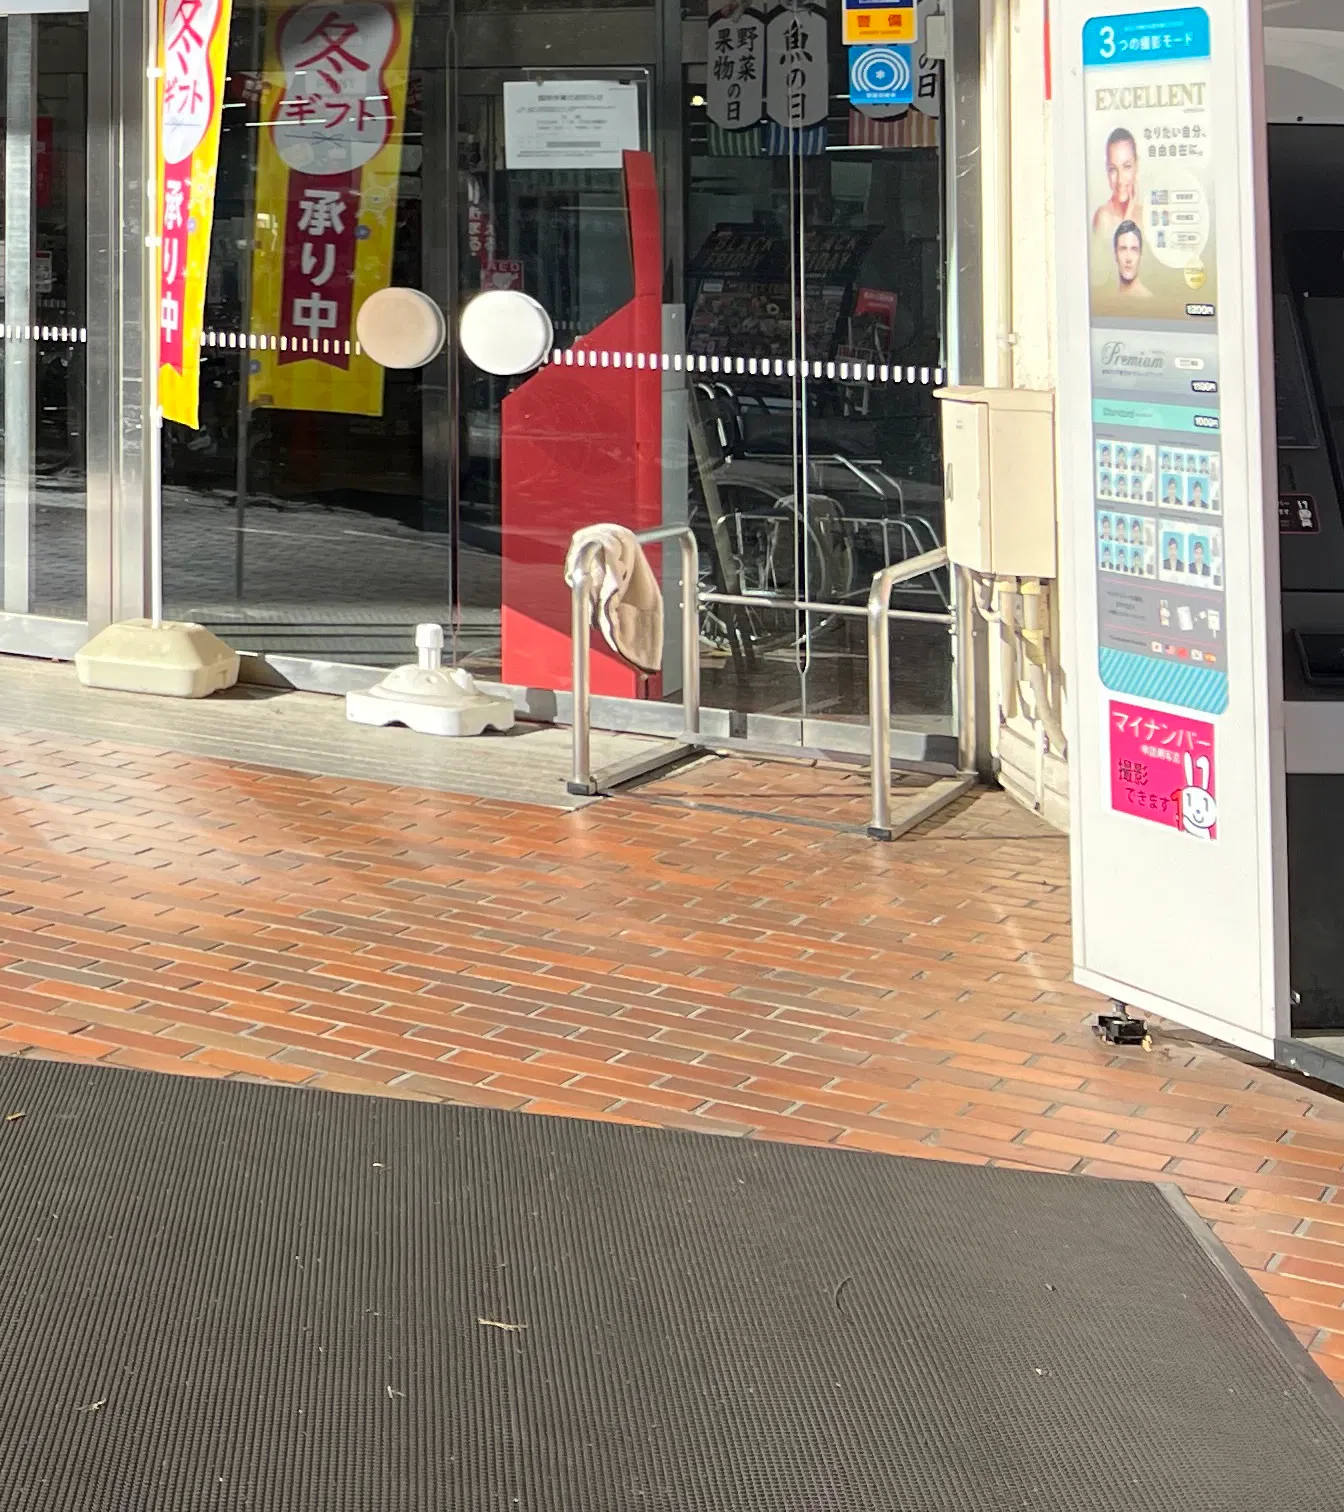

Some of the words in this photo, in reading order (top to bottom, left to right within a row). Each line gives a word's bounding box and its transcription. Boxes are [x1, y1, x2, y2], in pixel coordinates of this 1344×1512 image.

[295, 12, 370, 94] 冬
[713, 28, 735, 82] 果物
[737, 26, 758, 82] 野菜
[779, 19, 813, 120] 魚の日
[286, 94, 379, 133] ギフト
[1095, 82, 1207, 111] EXCELLENT
[160, 180, 182, 344] 承り中
[292, 190, 345, 340] 承り中
[1101, 341, 1164, 369] Premium
[1112, 710, 1212, 750] マイナンバー
[1117, 757, 1149, 786] 撮影
[1125, 787, 1170, 812] できます
